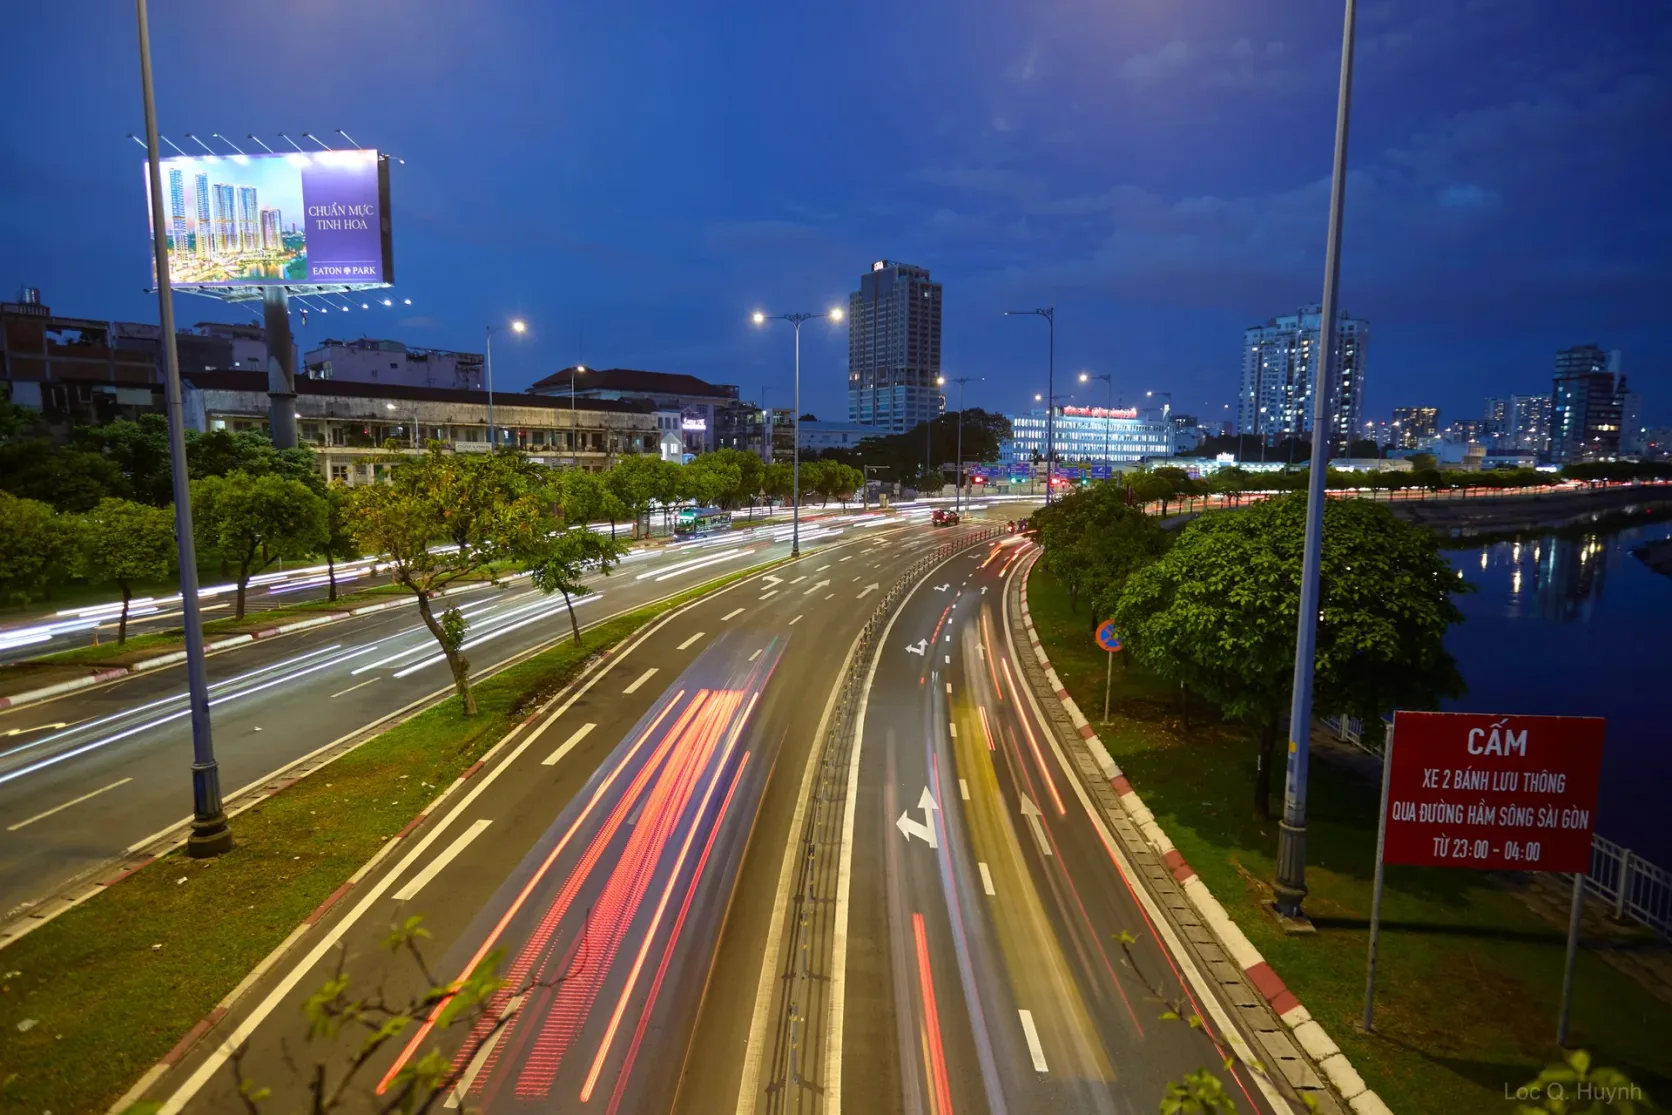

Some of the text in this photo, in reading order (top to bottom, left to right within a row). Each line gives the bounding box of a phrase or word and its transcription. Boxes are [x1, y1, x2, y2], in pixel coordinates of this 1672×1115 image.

[308, 202, 374, 217] CHUẨN MỰC
[316, 219, 368, 230] TINH HOA
[312, 266, 376, 275] EATON PARK
[1467, 718, 1528, 757] CẤM
[1422, 766, 1566, 793] XE 2 BÁNH LƯU THÔNG
[1392, 798, 1589, 830] QUA ĐƯỜNG HẦM SÔNG SÀI GÒN
[1433, 833, 1451, 857] TỪ
[1452, 838, 1489, 859] 23:00
[1504, 841, 1541, 862] 04:00
